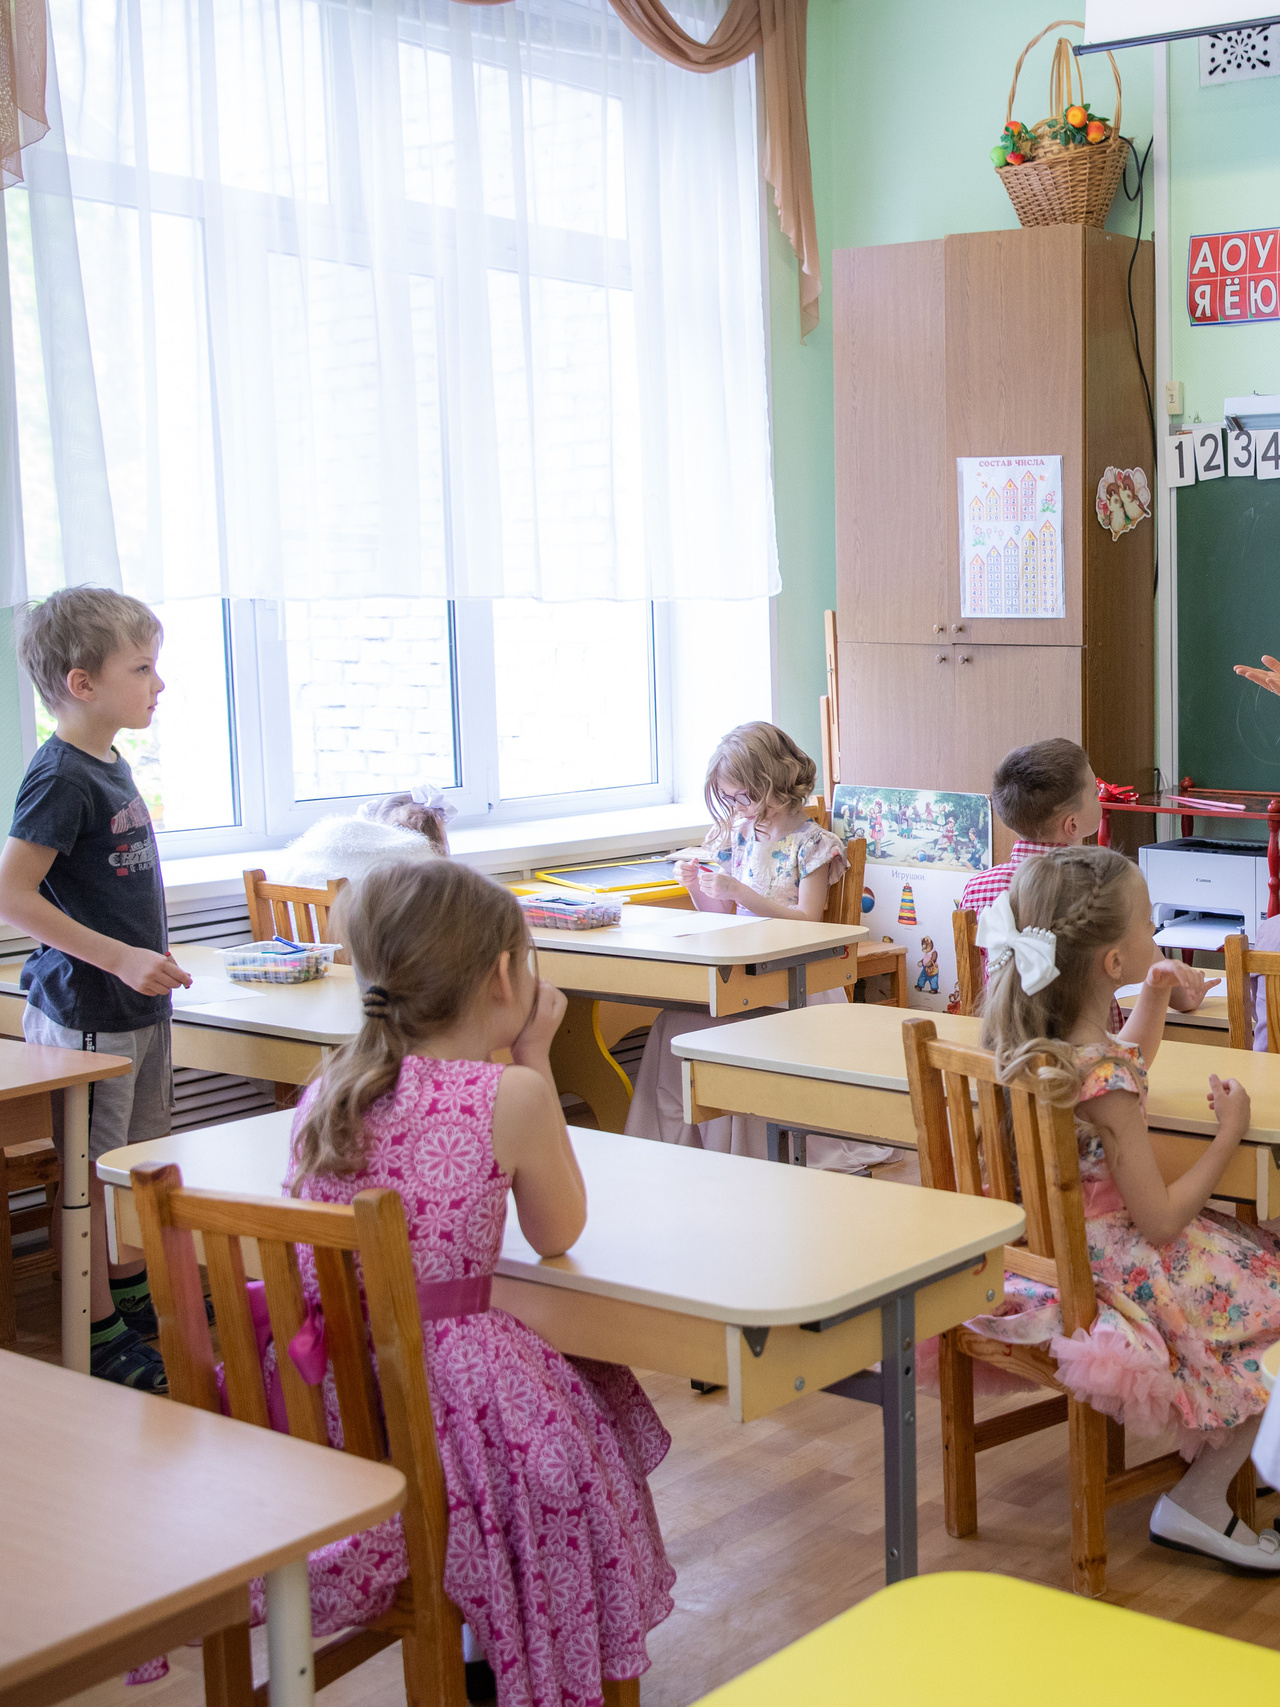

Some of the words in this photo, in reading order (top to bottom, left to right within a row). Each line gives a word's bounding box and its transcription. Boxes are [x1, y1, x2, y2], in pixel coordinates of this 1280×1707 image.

[1192, 241, 1216, 274] А
[1222, 238, 1246, 272] О
[1254, 234, 1274, 268] У
[1194, 284, 1212, 318] Я
[1224, 278, 1241, 316] Ё
[1250, 279, 1277, 314] Ю
[1174, 440, 1184, 478] 1
[1200, 433, 1221, 472] 2
[1234, 430, 1252, 468] 3
[892, 870, 924, 880] Игрушки
